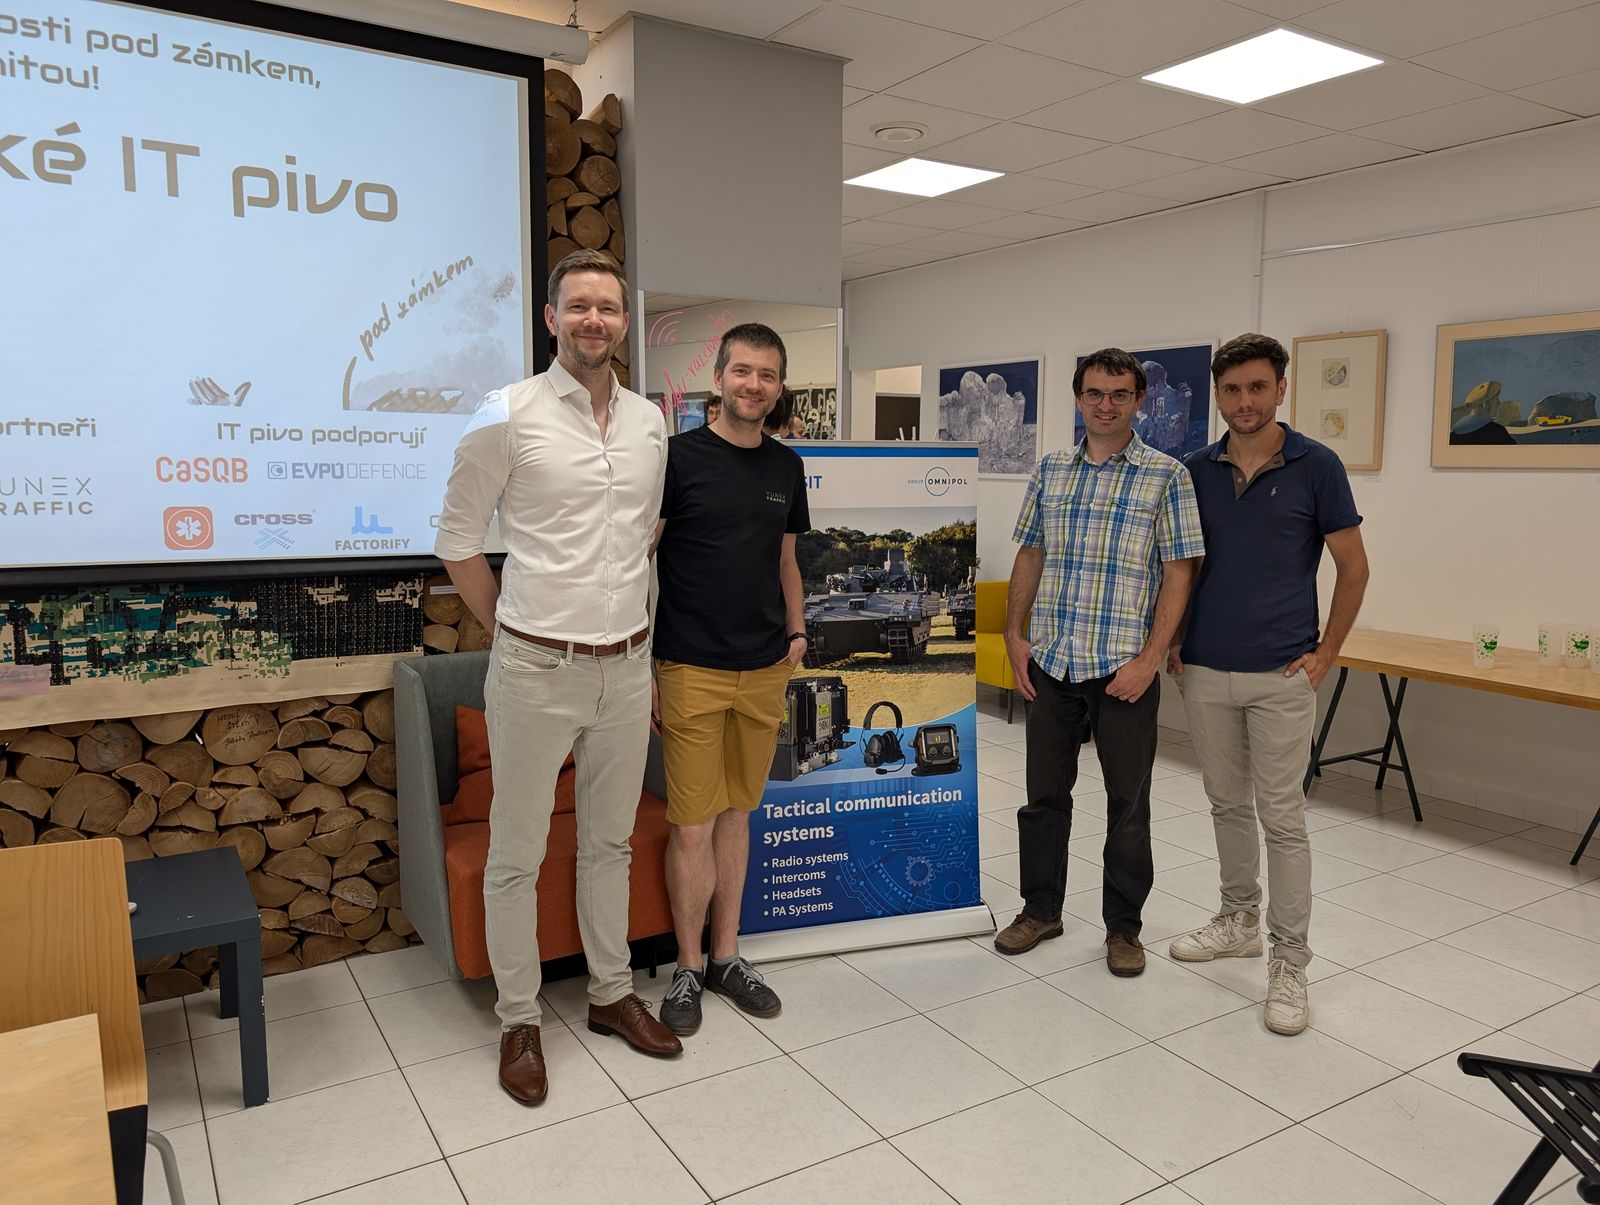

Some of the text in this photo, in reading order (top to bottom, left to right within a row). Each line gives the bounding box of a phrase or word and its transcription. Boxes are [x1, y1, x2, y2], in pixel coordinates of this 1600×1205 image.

[86, 29, 158, 58] pod
[172, 41, 322, 90] zámkem,
[121, 136, 200, 198] IT
[232, 154, 398, 223] pivo
[359, 255, 474, 362] pod zámkem
[0, 417, 97, 437] rtneři
[217, 422, 428, 449] IT pivo podporují
[155, 456, 249, 484] CaSQB
[234, 513, 313, 526] cross
[335, 538, 411, 551] FACTORIFY
[763, 787, 962, 819] Tactical communication
[763, 824, 835, 847] systems
[771, 851, 849, 869] Radio systems
[771, 870, 826, 884] Intercoms
[771, 885, 822, 901] Headsets
[772, 900, 834, 917] PA Systems
